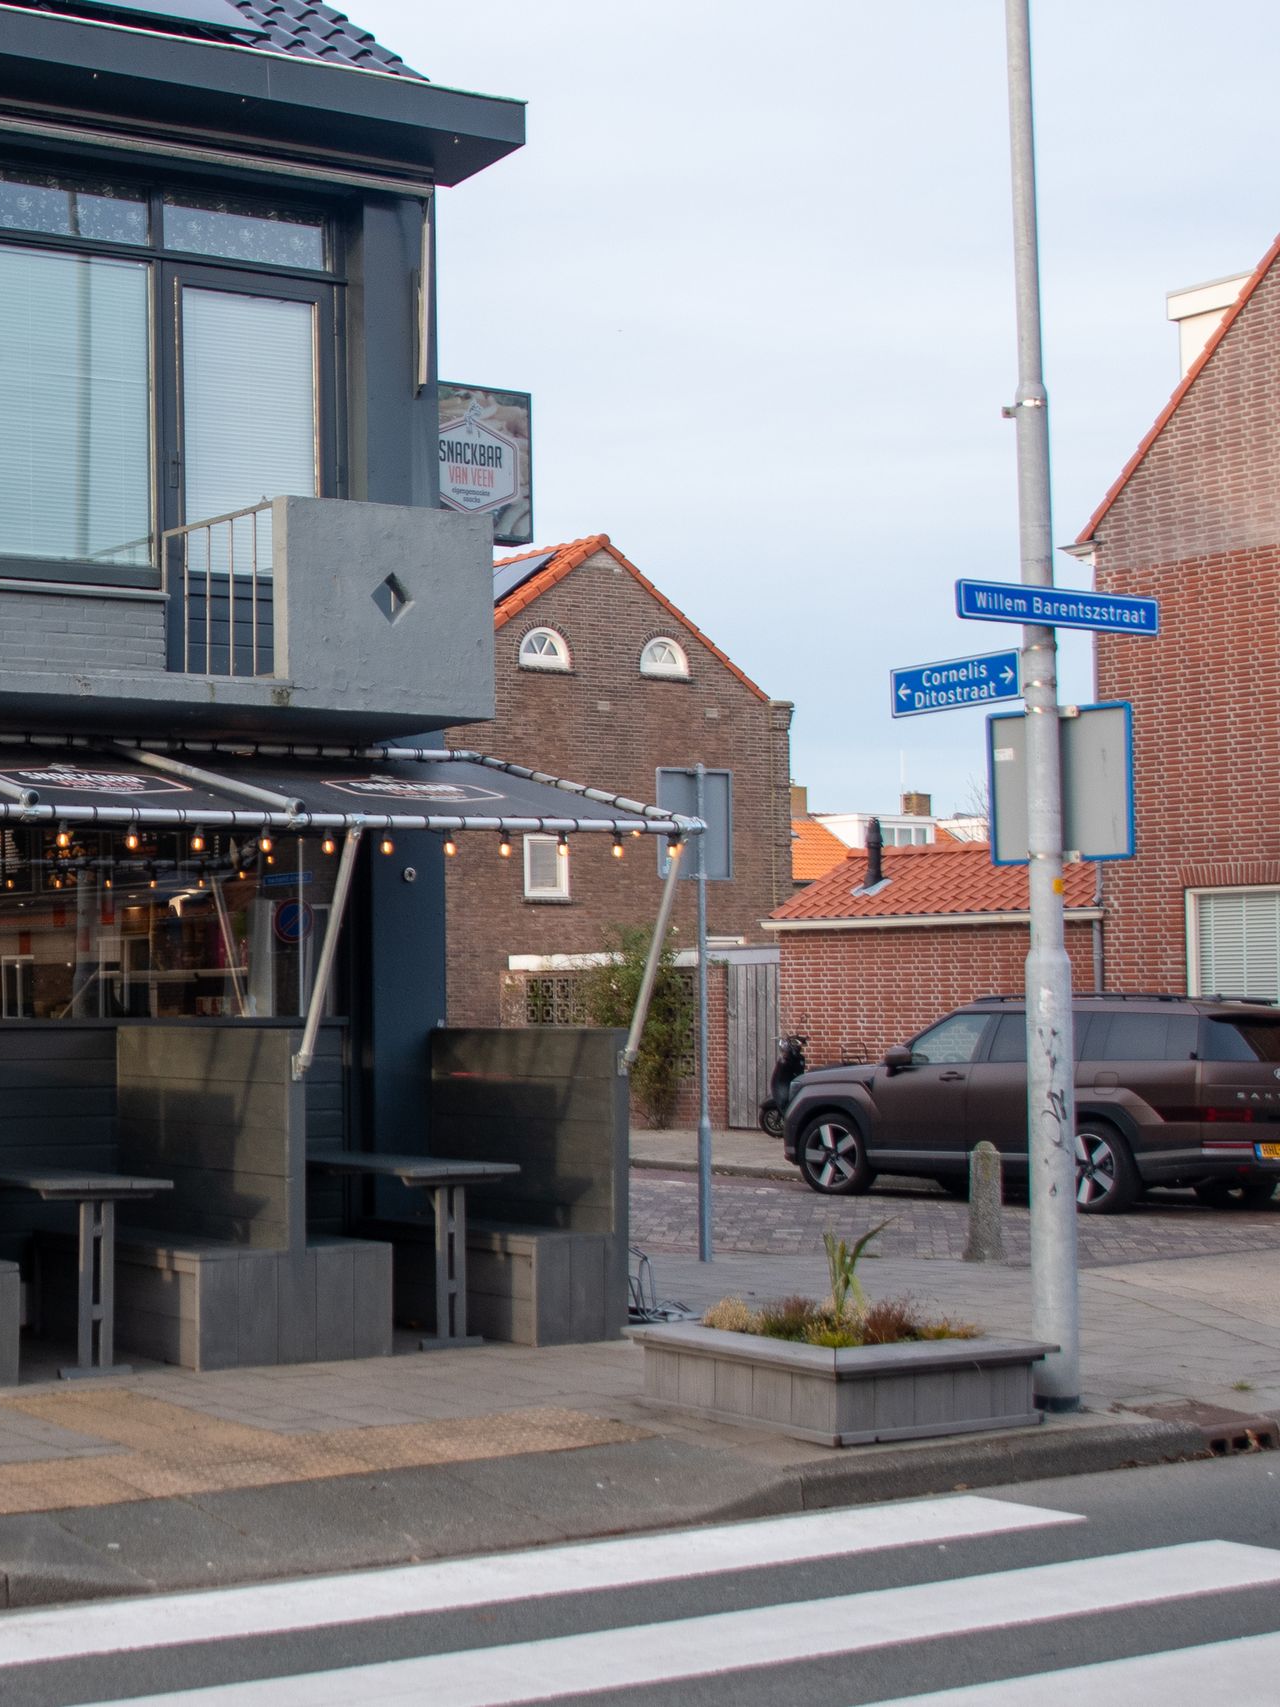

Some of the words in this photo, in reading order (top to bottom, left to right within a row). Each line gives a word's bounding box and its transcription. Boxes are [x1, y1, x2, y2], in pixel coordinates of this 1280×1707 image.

[439, 440, 502, 468] SNACKBAR
[449, 465, 468, 484] VAN
[471, 468, 494, 488] VEEN
[974, 591, 1027, 612] Willem
[1033, 597, 1146, 624] Barentszstraat
[922, 661, 988, 687] Cornelis
[915, 681, 997, 708] Ditostraat
